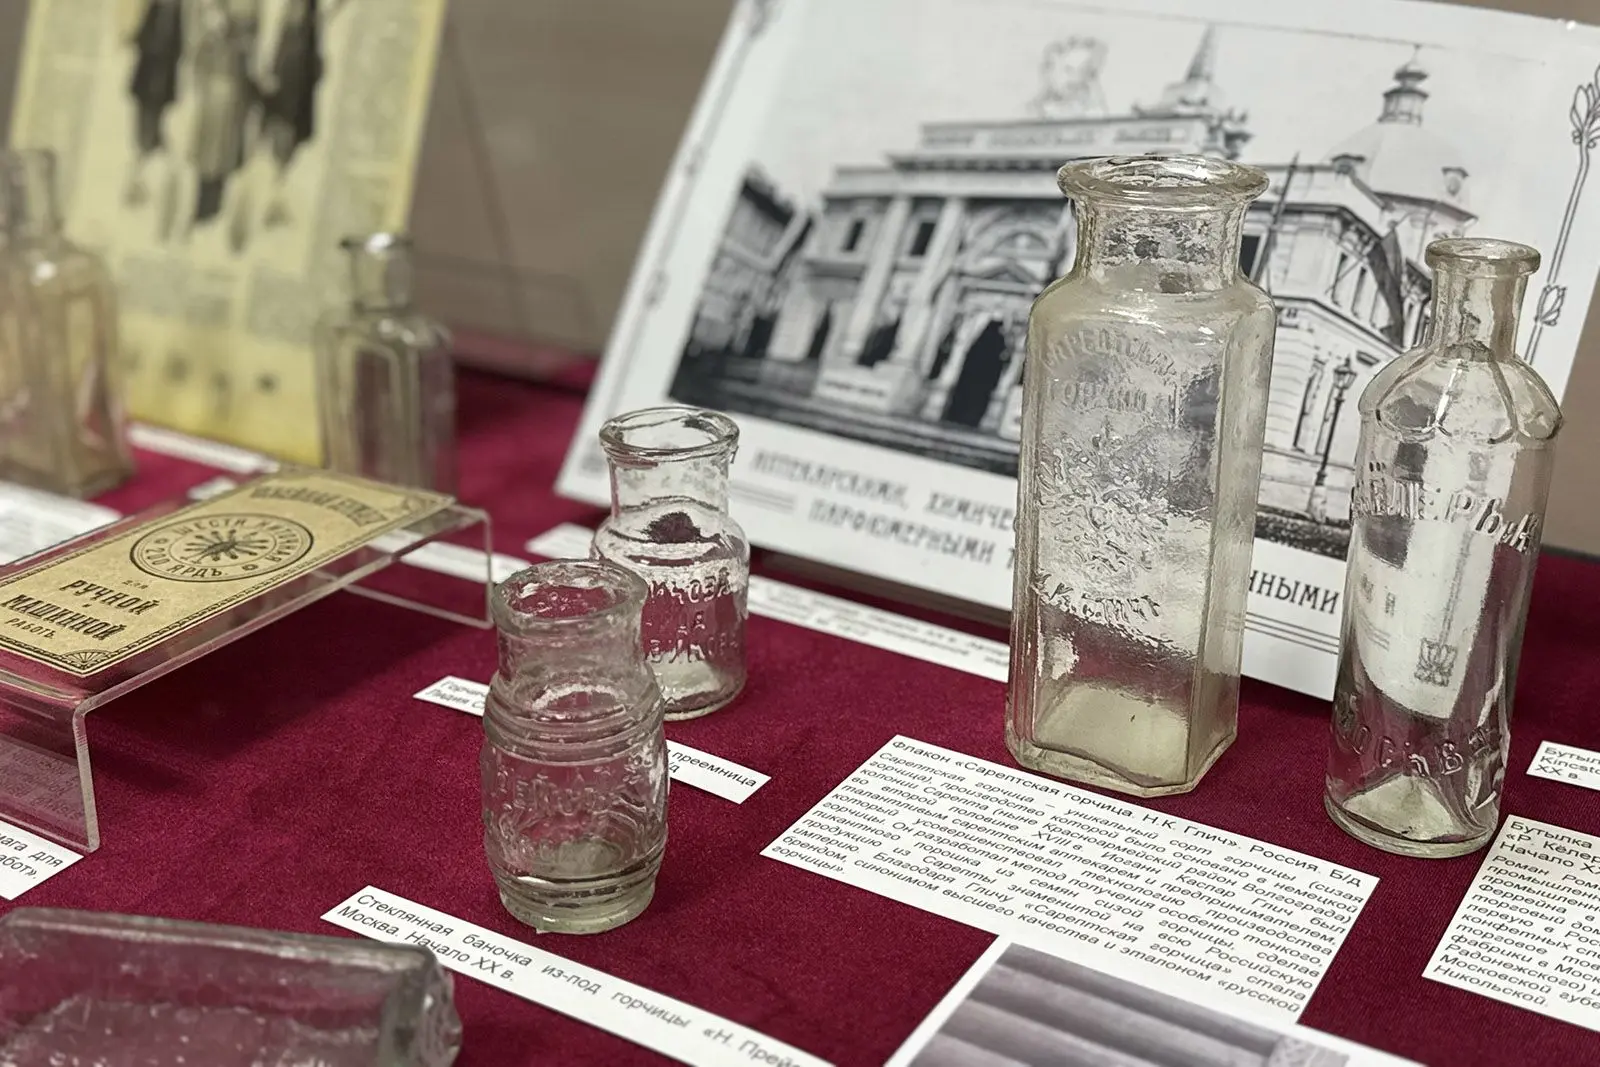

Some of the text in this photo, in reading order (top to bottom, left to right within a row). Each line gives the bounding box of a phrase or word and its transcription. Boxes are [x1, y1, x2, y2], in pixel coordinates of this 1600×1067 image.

[1, 594, 127, 641] МАШИННОЙ
[59, 579, 160, 615] РУЧНОЙ
[672, 751, 757, 787] преемница
[840, 784, 949, 821] талантливым
[951, 818, 1046, 851] сарептским
[1048, 848, 1141, 880] аптекарем
[1144, 877, 1157, 886] и
[879, 752, 967, 783] Сарептская
[974, 781, 1035, 804] горчица
[1063, 808, 1159, 840] уникальный
[1169, 839, 1213, 856] сорт
[1223, 855, 1297, 882] горчицы
[1308, 880, 1365, 904] (сизая
[892, 741, 952, 764] Флакон
[954, 761, 1061, 796] «Сарептская
[1328, 868, 1362, 888] Б/д
[1510, 820, 1592, 849] Бутылка
[28, 851, 63, 867] для
[851, 776, 870, 786] во
[880, 785, 938, 806] второй
[947, 805, 1020, 831] половине
[1100, 851, 1162, 875] Иоганн
[1174, 873, 1236, 898] Каспар
[1250, 897, 1294, 917] Глич
[1309, 916, 1347, 934] был
[859, 768, 1352, 925] колонии Сарепта (ныне Красноармейский район Волгограда)
[939, 782, 1046, 817] производство
[1049, 815, 1120, 839] которой
[1123, 836, 1167, 853] было
[1172, 851, 1250, 879] основано
[1273, 882, 1359, 914] немецкой
[1499, 840, 1575, 868] Начало
[811, 809, 902, 841] пикантного
[913, 841, 982, 867] порошка
[995, 867, 1015, 878] из
[1028, 878, 1080, 898] семян
[1094, 899, 1144, 919] сизой
[1256, 951, 1321, 978] сделав
[831, 793, 1333, 956] который усовершенствовал технологию производства
[891, 821, 915, 834] Он
[912, 830, 1010, 864] разработал
[1010, 860, 1068, 881] метод
[1067, 878, 1156, 910] получения
[1157, 906, 1240, 937] особенно
[1481, 874, 1600, 912] промышленн
[1491, 854, 1600, 891] Роман Ром
[801, 818, 1314, 990] продукцию из Сарепты знаменитой на всю Российскую
[1471, 893, 1566, 925] торговый
[1478, 882, 1568, 915] Феррейна
[336, 905, 400, 938] Москва.
[403, 930, 471, 963] Начало
[853, 859, 940, 892] синонимом
[941, 888, 1015, 917] высшего
[1017, 913, 1100, 945] качества
[1103, 941, 1117, 950] и
[1119, 946, 1212, 982] эталоном
[1217, 979, 1301, 1013] «русской
[872, 851, 957, 884] Благодаря
[964, 881, 1015, 903] Гличу
[1024, 902, 1139, 944] «Сарептская
[1246, 975, 1307, 1001] стала
[1450, 934, 1533, 963] фабрики
[1455, 923, 1548, 955] торговое
[1460, 913, 1600, 960] конфетных сп
[1465, 903, 1534, 928] первую
[1563, 930, 1600, 947] Рос
[356, 894, 455, 937] Стеклянная
[461, 933, 533, 967] баночка
[540, 964, 602, 996] из-под
[610, 991, 692, 1028] горчицы
[738, 1039, 800, 1067] Прей
[1439, 953, 1552, 994] Московской
